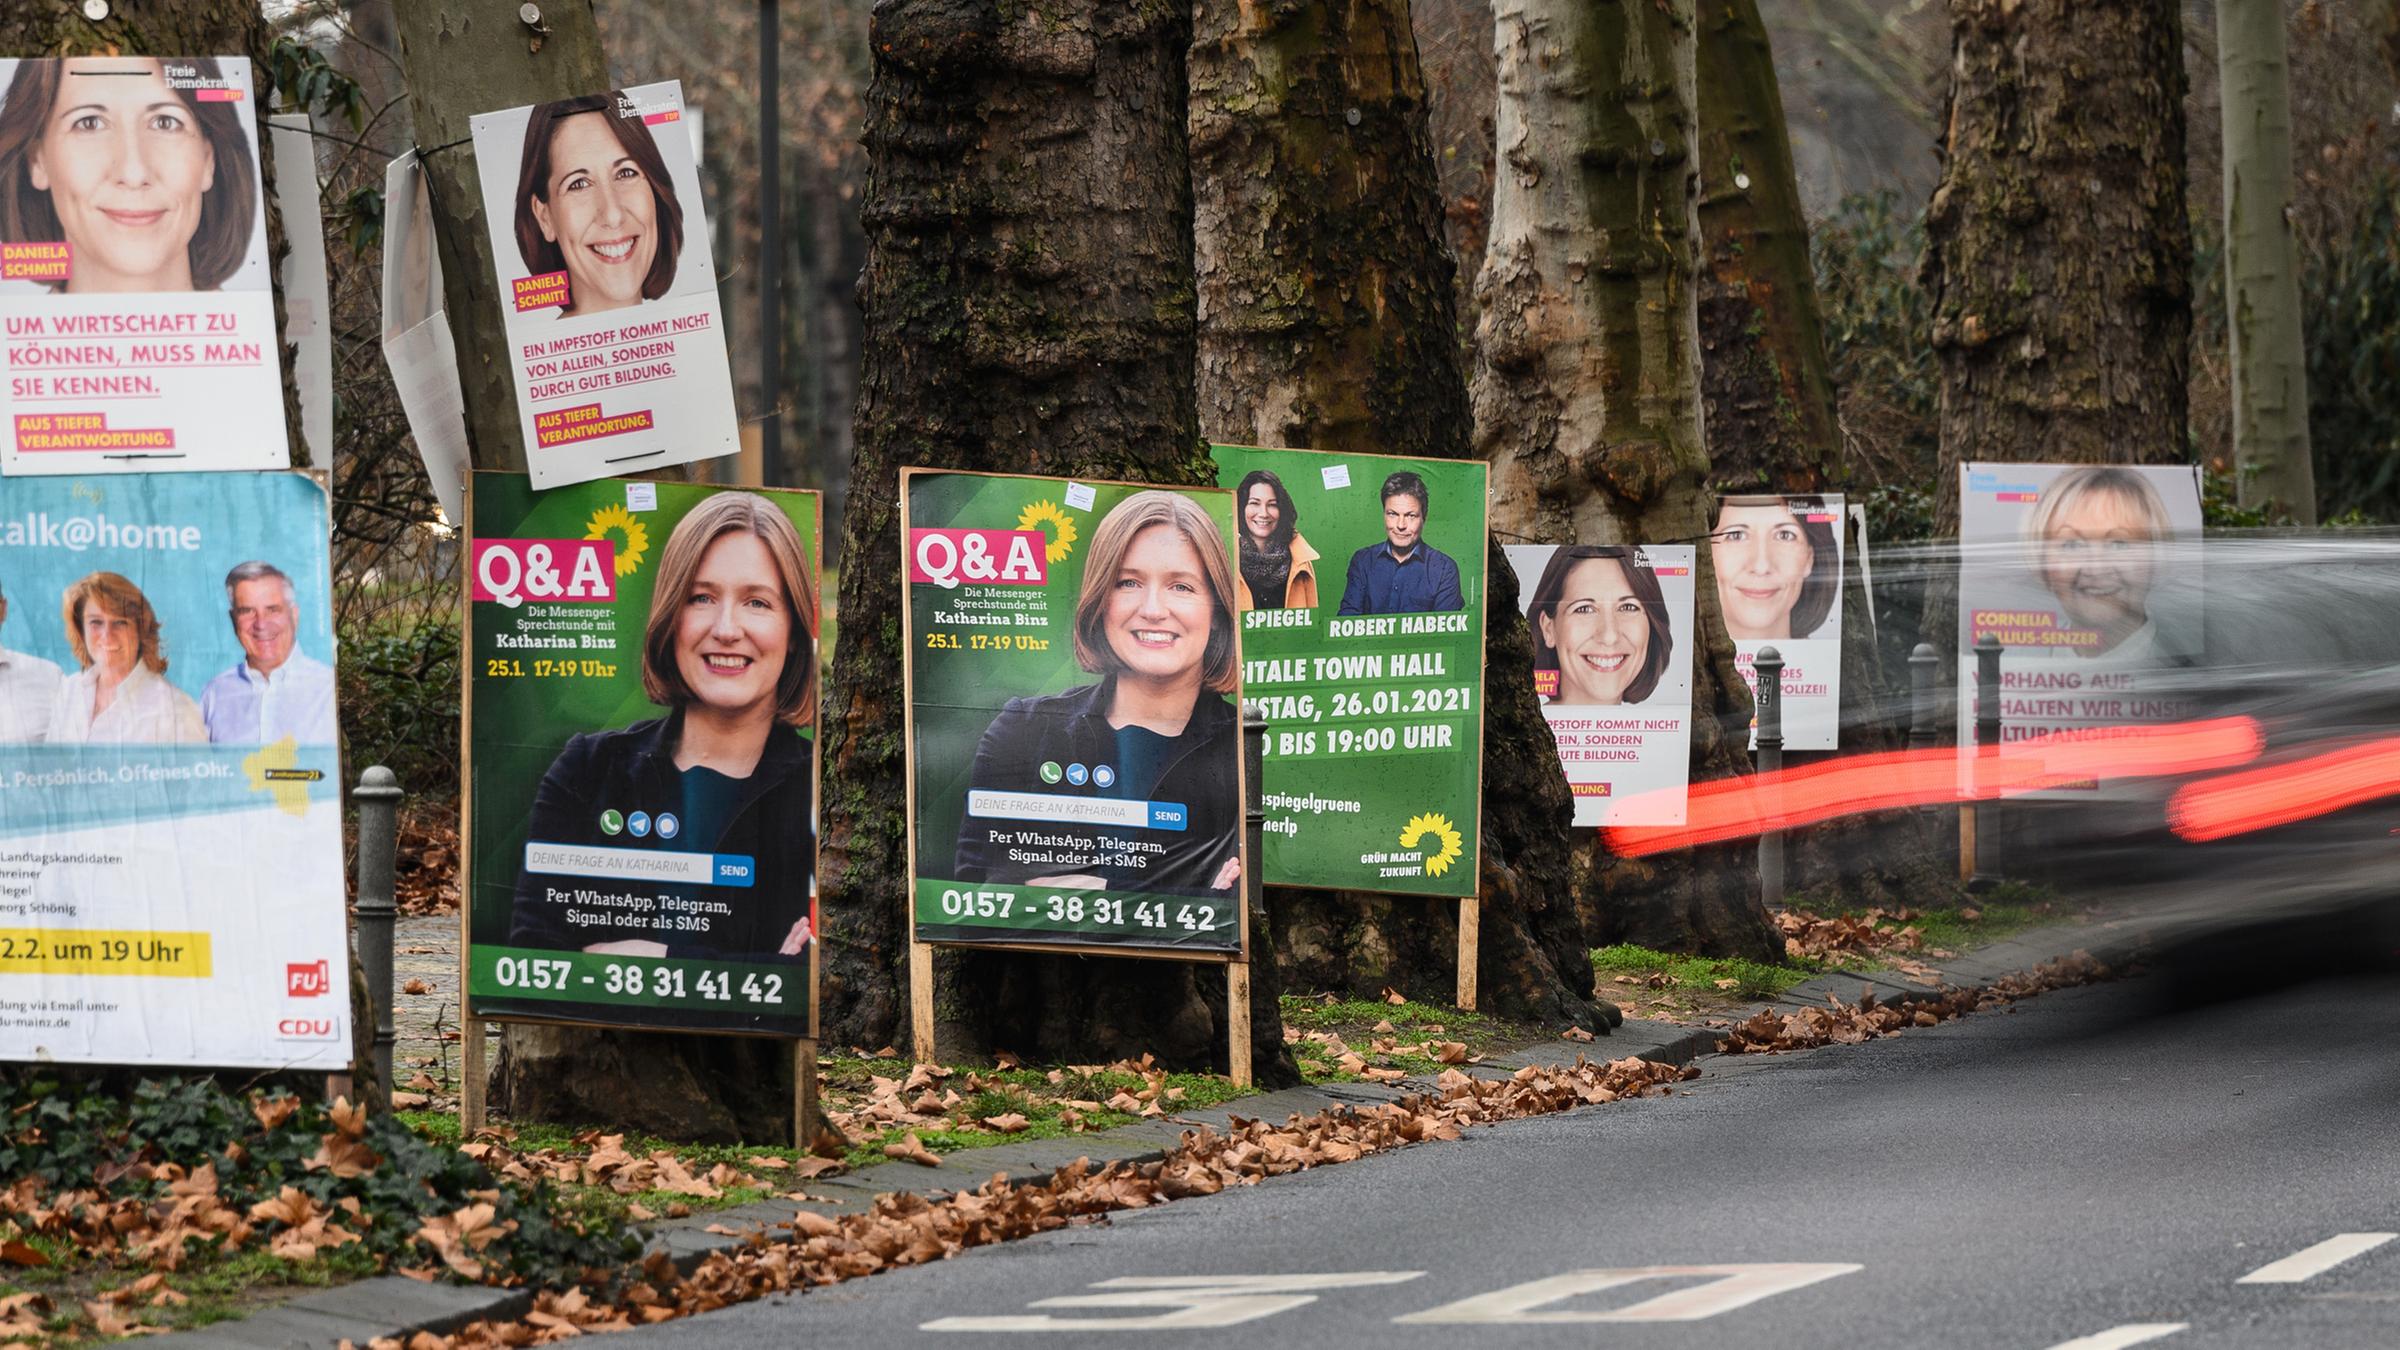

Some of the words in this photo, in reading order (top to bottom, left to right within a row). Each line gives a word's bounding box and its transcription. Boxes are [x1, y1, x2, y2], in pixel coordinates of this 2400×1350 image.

[164, 64, 196, 77] Freie
[4, 246, 69, 260] DANIELA
[5, 262, 67, 276] SCHMITT
[516, 275, 566, 293] DANIELA
[518, 290, 566, 309] SCHMITT
[6, 317, 46, 335] UM
[53, 314, 197, 334] WIRTSCHAFT
[206, 313, 238, 331] ZU
[523, 343, 545, 358] EIN
[549, 331, 616, 354] IMPFSTOFF
[619, 321, 668, 341] KOMMT
[672, 313, 710, 332] NICHT
[9, 342, 122, 367] KÖNNEN,
[131, 345, 195, 363] MUSS
[204, 343, 262, 361] MAN
[526, 364, 557, 378] VON
[562, 354, 608, 372] ALLEIN,
[612, 341, 675, 363] SONDERN
[12, 378, 44, 396] SIE
[53, 376, 161, 395] KENNEN.
[530, 380, 575, 399] DURCH
[579, 373, 611, 389] GUTE
[615, 362, 676, 383] BILDUNG.
[20, 417, 51, 431] AUS
[55, 415, 103, 430] TIEFER
[539, 414, 562, 429] AUS
[564, 407, 600, 424] TIEFER
[540, 415, 650, 445] VERANTWORTUNG.
[20, 432, 171, 449] VERANTWORTUNG.
[916, 533, 1042, 589] Q&A
[479, 543, 610, 608] Q&A
[965, 587, 983, 598] Die
[985, 588, 1047, 601] Messenger-
[529, 606, 547, 618] Die
[550, 605, 616, 620] Messenger-
[954, 598, 1027, 611] Sprechstunde
[1029, 600, 1047, 610] mit
[516, 619, 594, 633] Sprechstunde
[597, 620, 616, 631] mit
[934, 611, 1010, 625] Katharina
[1014, 613, 1049, 625] Binz
[1245, 609, 1313, 630] SPIEGEL
[1329, 617, 1396, 638] ROBERT
[1401, 614, 1468, 635] HABECK
[1976, 612, 2052, 627] CORNELIA
[496, 634, 577, 649] Katharina
[581, 635, 617, 649] Binz
[927, 633, 962, 649] 25.1.
[970, 635, 1012, 650] 17-19
[1015, 635, 1049, 650] Uhr
[488, 659, 526, 677] 25.1.
[534, 660, 577, 677] 17-19
[581, 660, 617, 678] Uhr
[1313, 655, 1382, 682] TOWN
[1390, 652, 1446, 678] HALL
[2090, 672, 2136, 690] AUF:
[1331, 687, 1471, 717] 26.01.2021
[2082, 700, 2121, 717] WIR
[1596, 719, 1641, 730] KOMMT
[1644, 719, 1680, 730] NICHT
[1279, 732, 1316, 756] BIS
[1327, 727, 1396, 754] 19:00
[1403, 724, 1453, 749] UHR
[1555, 735, 1581, 746] EIN,
[1585, 735, 1643, 745] SONDERN
[1557, 750, 1580, 760] UTE
[1584, 750, 1640, 760] BILDUNG.
[15, 766, 115, 788] Persönlich.
[119, 763, 192, 784] Offenes
[194, 761, 235, 779] Ohr.
[975, 798, 1008, 811] DEINE
[1009, 799, 1044, 813] FRAGE
[1046, 801, 1063, 814] AN
[1065, 802, 1126, 818] KATHARINA
[1155, 810, 1181, 823] SEND
[989, 831, 1013, 844] Per
[1015, 832, 1096, 851] WhatsApp,
[1098, 836, 1167, 855] Telegram,
[532, 851, 566, 866] DEINE
[568, 852, 604, 869] FRAGE
[606, 855, 623, 870] AN
[625, 856, 690, 874] KATHARINA
[720, 864, 749, 877] SEND
[1009, 849, 1053, 865] Signal
[1056, 852, 1089, 865] oder
[1092, 853, 1112, 866] als
[1114, 854, 1147, 868] SMS
[1361, 852, 1388, 864] GRÜN
[1390, 851, 1423, 863] MACHT
[1379, 866, 1423, 878] ZUKUNFT
[0, 884, 32, 900] legel
[30, 902, 77, 917] Schönig
[546, 888, 572, 903] Per
[574, 890, 656, 912] WhatsApp,
[658, 895, 732, 917] Telegram,
[942, 890, 1015, 918] 0157
[1047, 896, 1085, 922] 38
[1094, 899, 1124, 926] 31
[1134, 902, 1168, 929] 41
[1177, 904, 1216, 932] 42
[567, 909, 611, 928] Signal
[615, 915, 648, 928] oder
[652, 916, 674, 930] als
[676, 917, 711, 932] SMS
[1, 938, 46, 960] 2.2.
[54, 944, 93, 961] um
[101, 940, 130, 961] 19
[138, 940, 184, 962] Uhr
[290, 963, 327, 991] FU!
[496, 956, 572, 990] 0157
[582, 976, 594, 984] -
[605, 964, 644, 995] 38
[653, 967, 686, 998] 31
[696, 970, 731, 1001] 41
[741, 973, 783, 1004] 42
[30, 1001, 48, 1011] via
[51, 1000, 83, 1012] Email
[87, 1001, 119, 1012] unter
[279, 1020, 331, 1035] CDU
